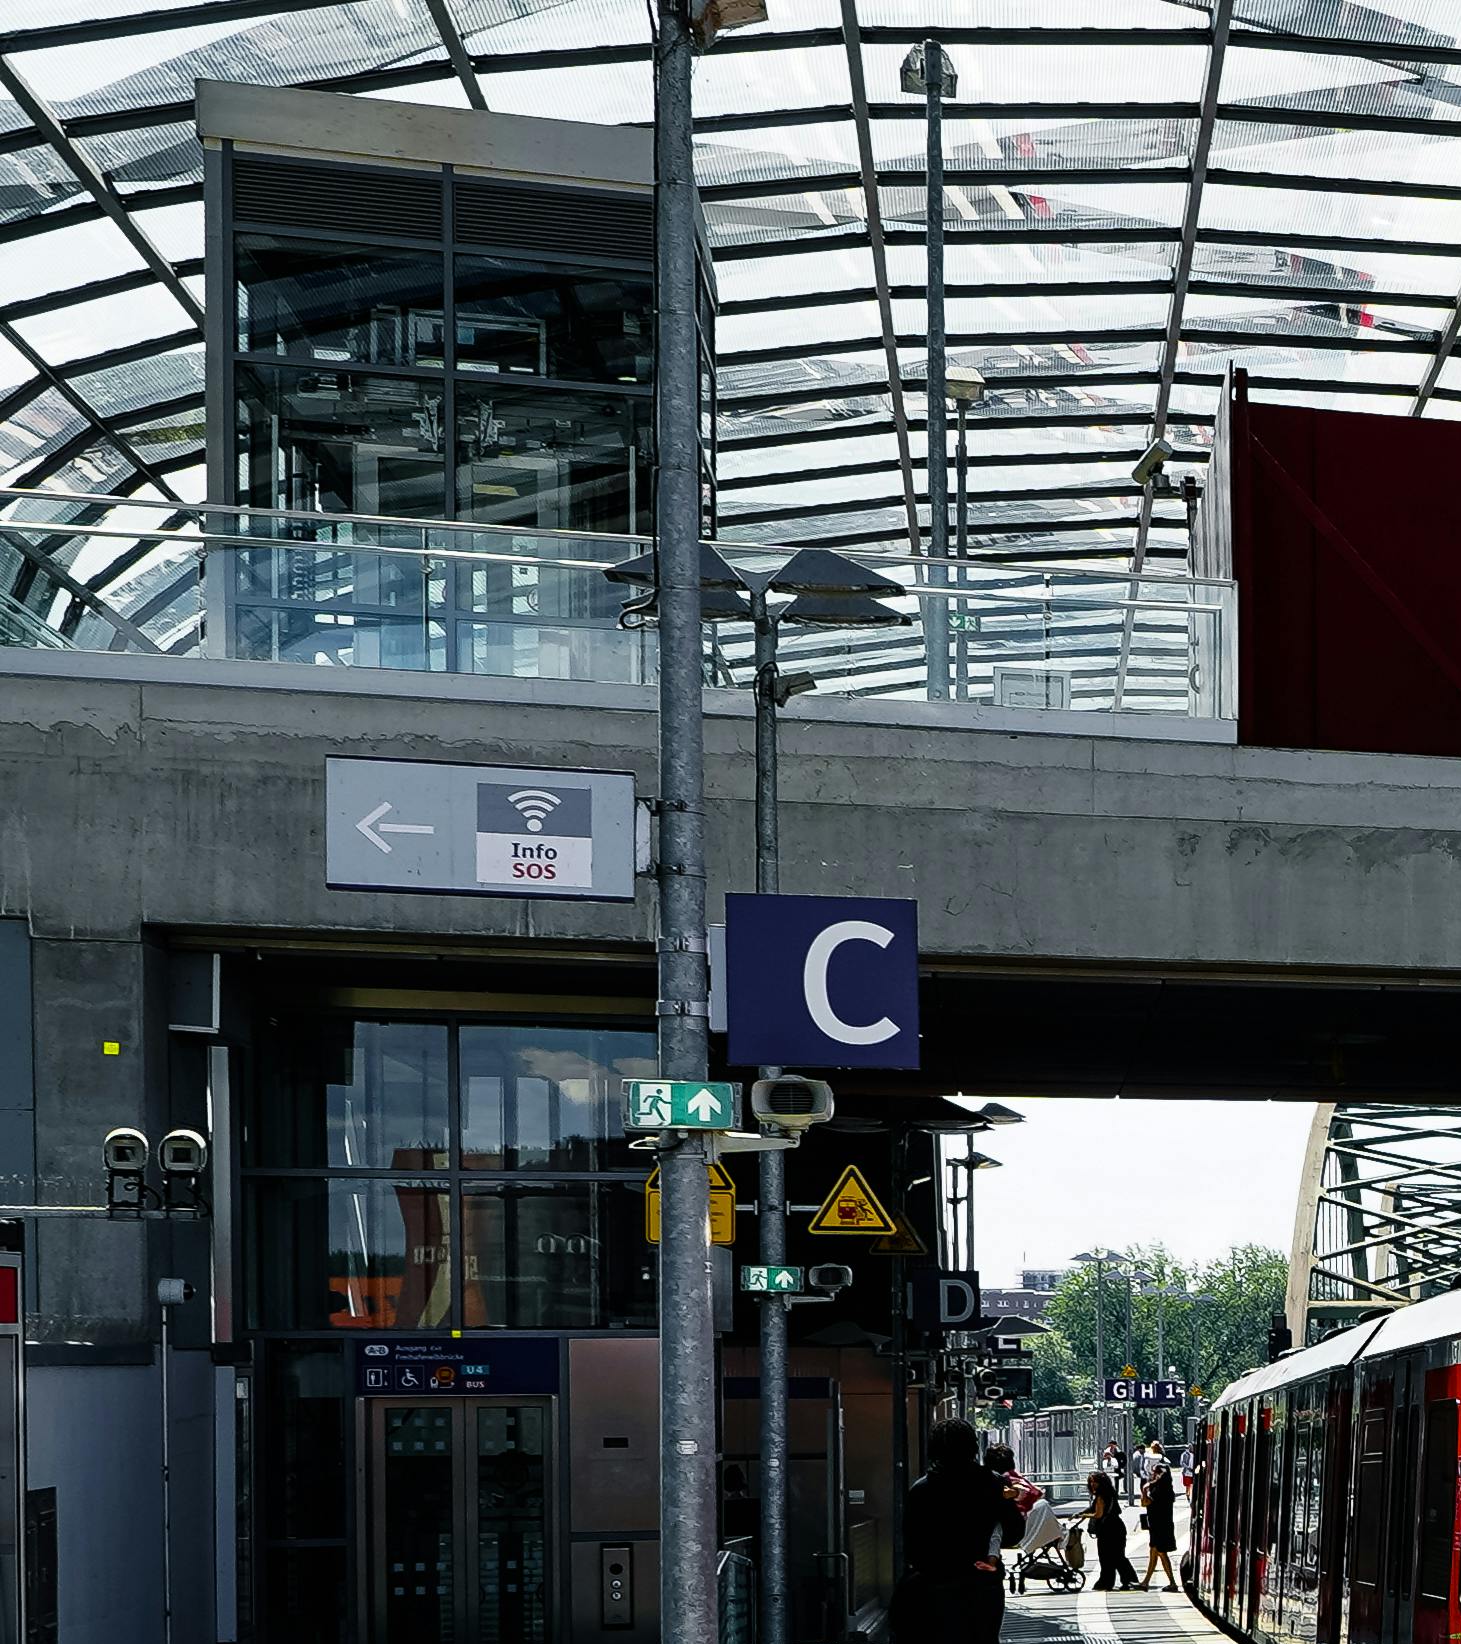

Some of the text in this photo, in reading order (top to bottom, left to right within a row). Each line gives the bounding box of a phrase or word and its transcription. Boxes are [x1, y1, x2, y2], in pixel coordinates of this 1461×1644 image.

[511, 842, 558, 861] Info
[511, 862, 557, 880] SOS
[803, 920, 901, 1046] C
[939, 1279, 975, 1323] D
[466, 1381, 485, 1389] BUS
[1112, 1381, 1127, 1399] G
[1141, 1383, 1153, 1399] H
